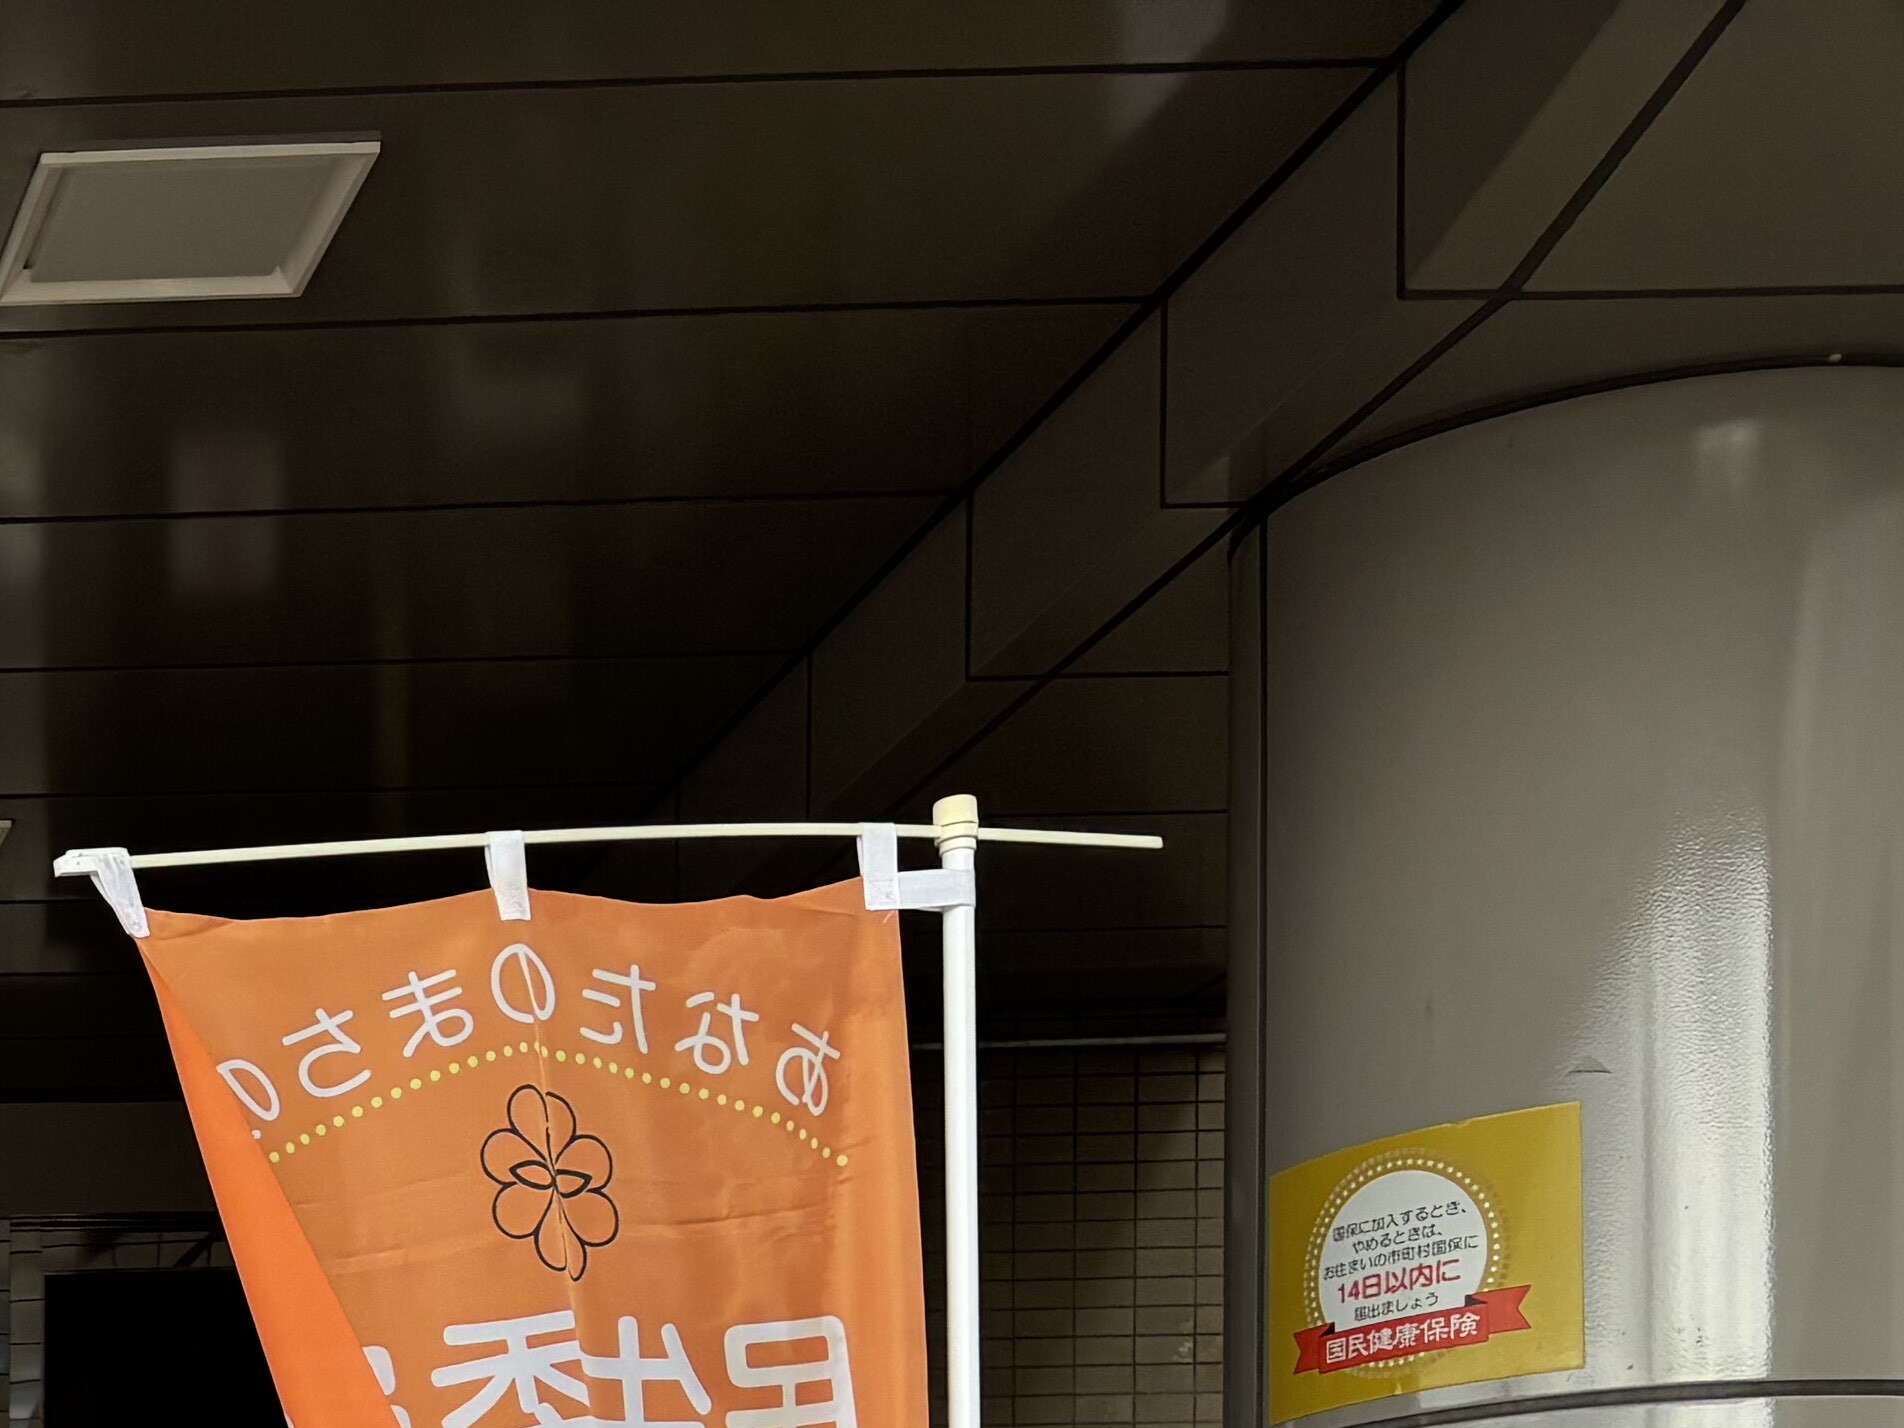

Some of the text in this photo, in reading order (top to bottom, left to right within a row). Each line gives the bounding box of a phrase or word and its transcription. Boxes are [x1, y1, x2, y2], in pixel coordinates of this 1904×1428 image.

[1337, 1258, 1462, 1304] 14日以内に
[1326, 1312, 1481, 1364] 国民健康保険
